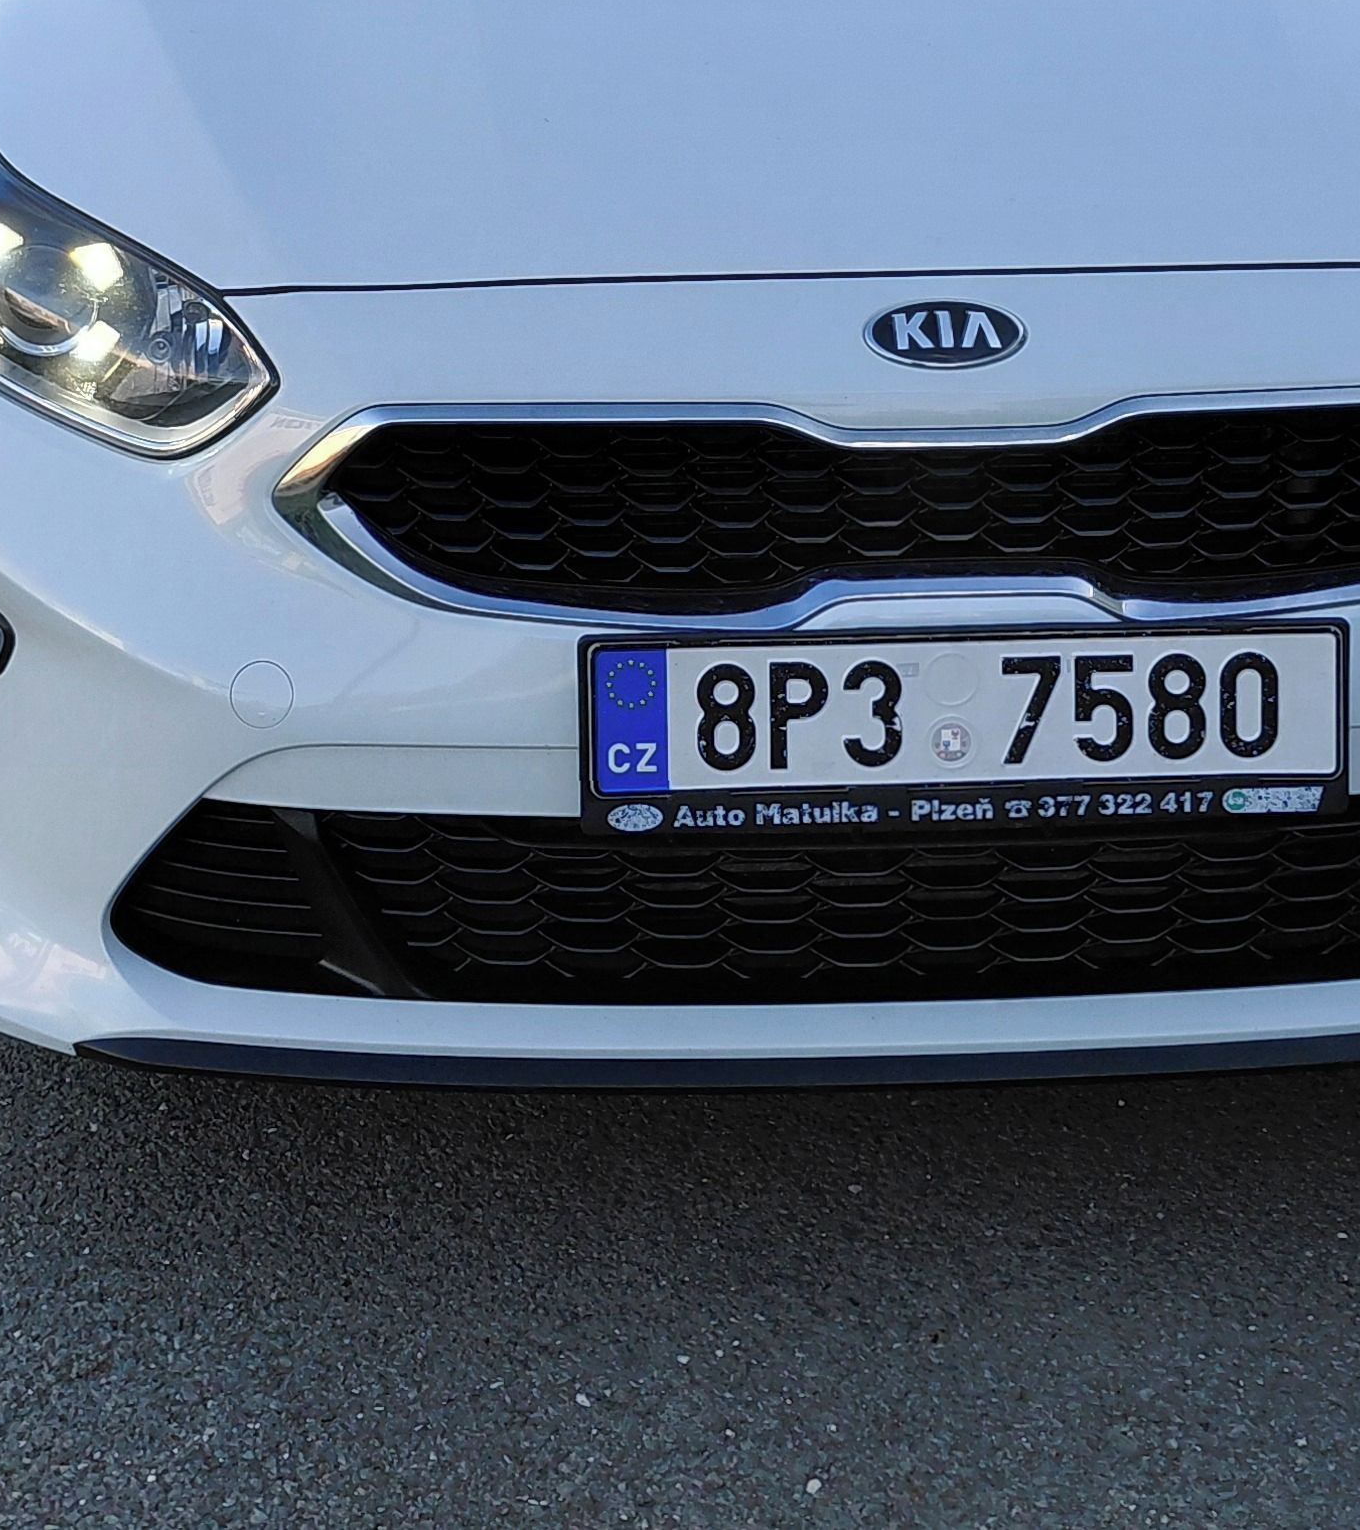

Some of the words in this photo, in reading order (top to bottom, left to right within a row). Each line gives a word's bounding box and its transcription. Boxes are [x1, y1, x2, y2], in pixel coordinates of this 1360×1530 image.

[891, 309, 1002, 350] KIA
[696, 660, 903, 771] 8P3
[1001, 651, 1279, 765] 7580
[608, 742, 658, 773] CZ
[673, 805, 745, 827] Auto
[756, 801, 878, 825] Matulka
[911, 798, 993, 821] Plzeň
[1038, 795, 1090, 817] 377
[1099, 793, 1152, 815] 322
[1160, 791, 1213, 813] 417
